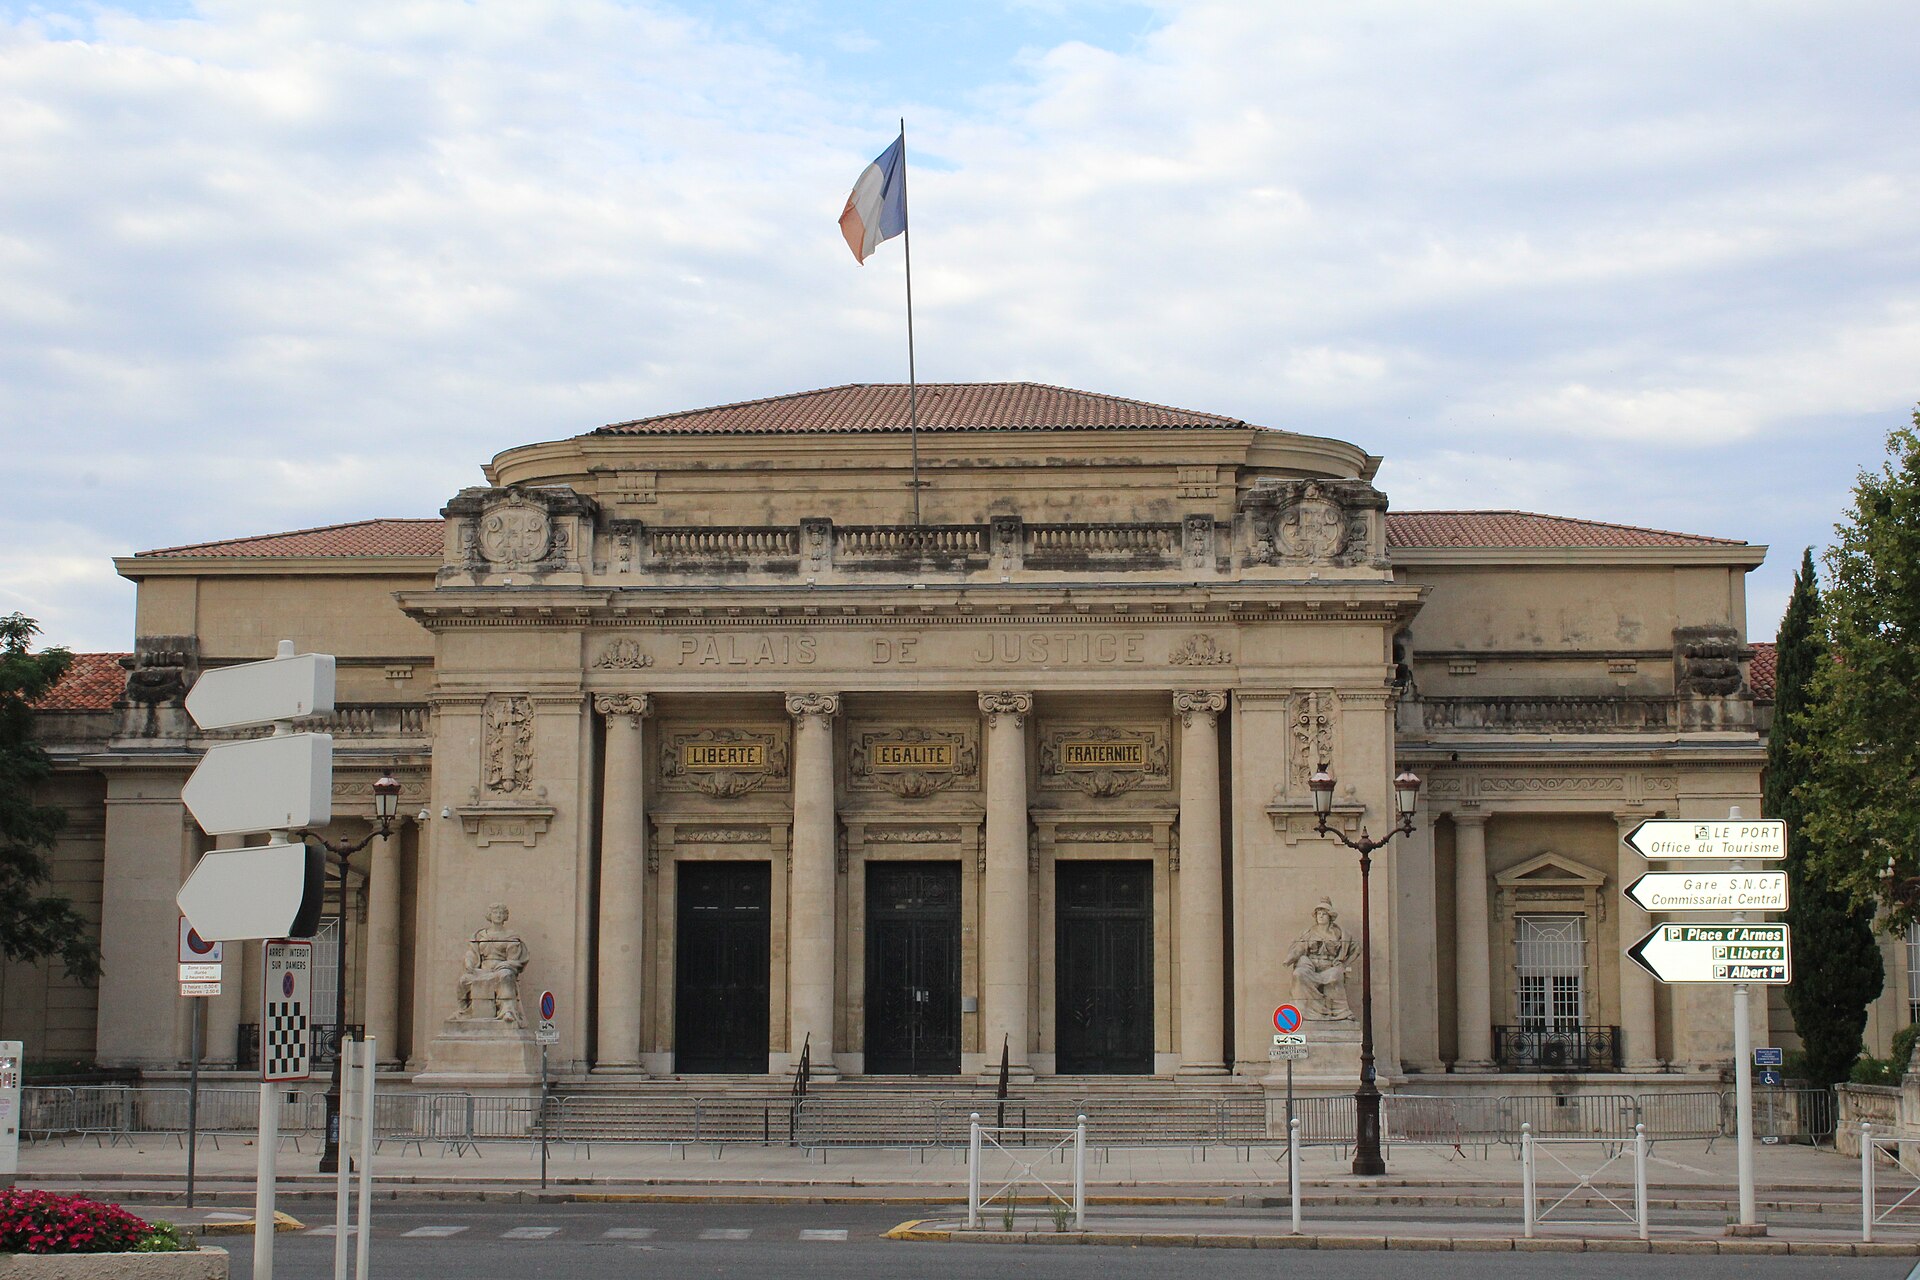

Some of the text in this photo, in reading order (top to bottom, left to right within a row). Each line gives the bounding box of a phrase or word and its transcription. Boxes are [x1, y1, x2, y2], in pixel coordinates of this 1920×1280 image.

[677, 633, 1145, 665] PALAIS DE JUSTICE
[1714, 827, 1780, 838] LE PORT
[1651, 842, 1780, 853] Office du Tourisme
[1683, 879, 1718, 890] Gare
[1651, 893, 1782, 905] Commissariat Central
[1687, 928, 1723, 941] Place
[269, 948, 310, 957] ARRET INTERDIT
[1729, 947, 1780, 959] Liberté
[271, 961, 307, 970] SUR DAMIERS
[1730, 967, 1768, 978] Albert
